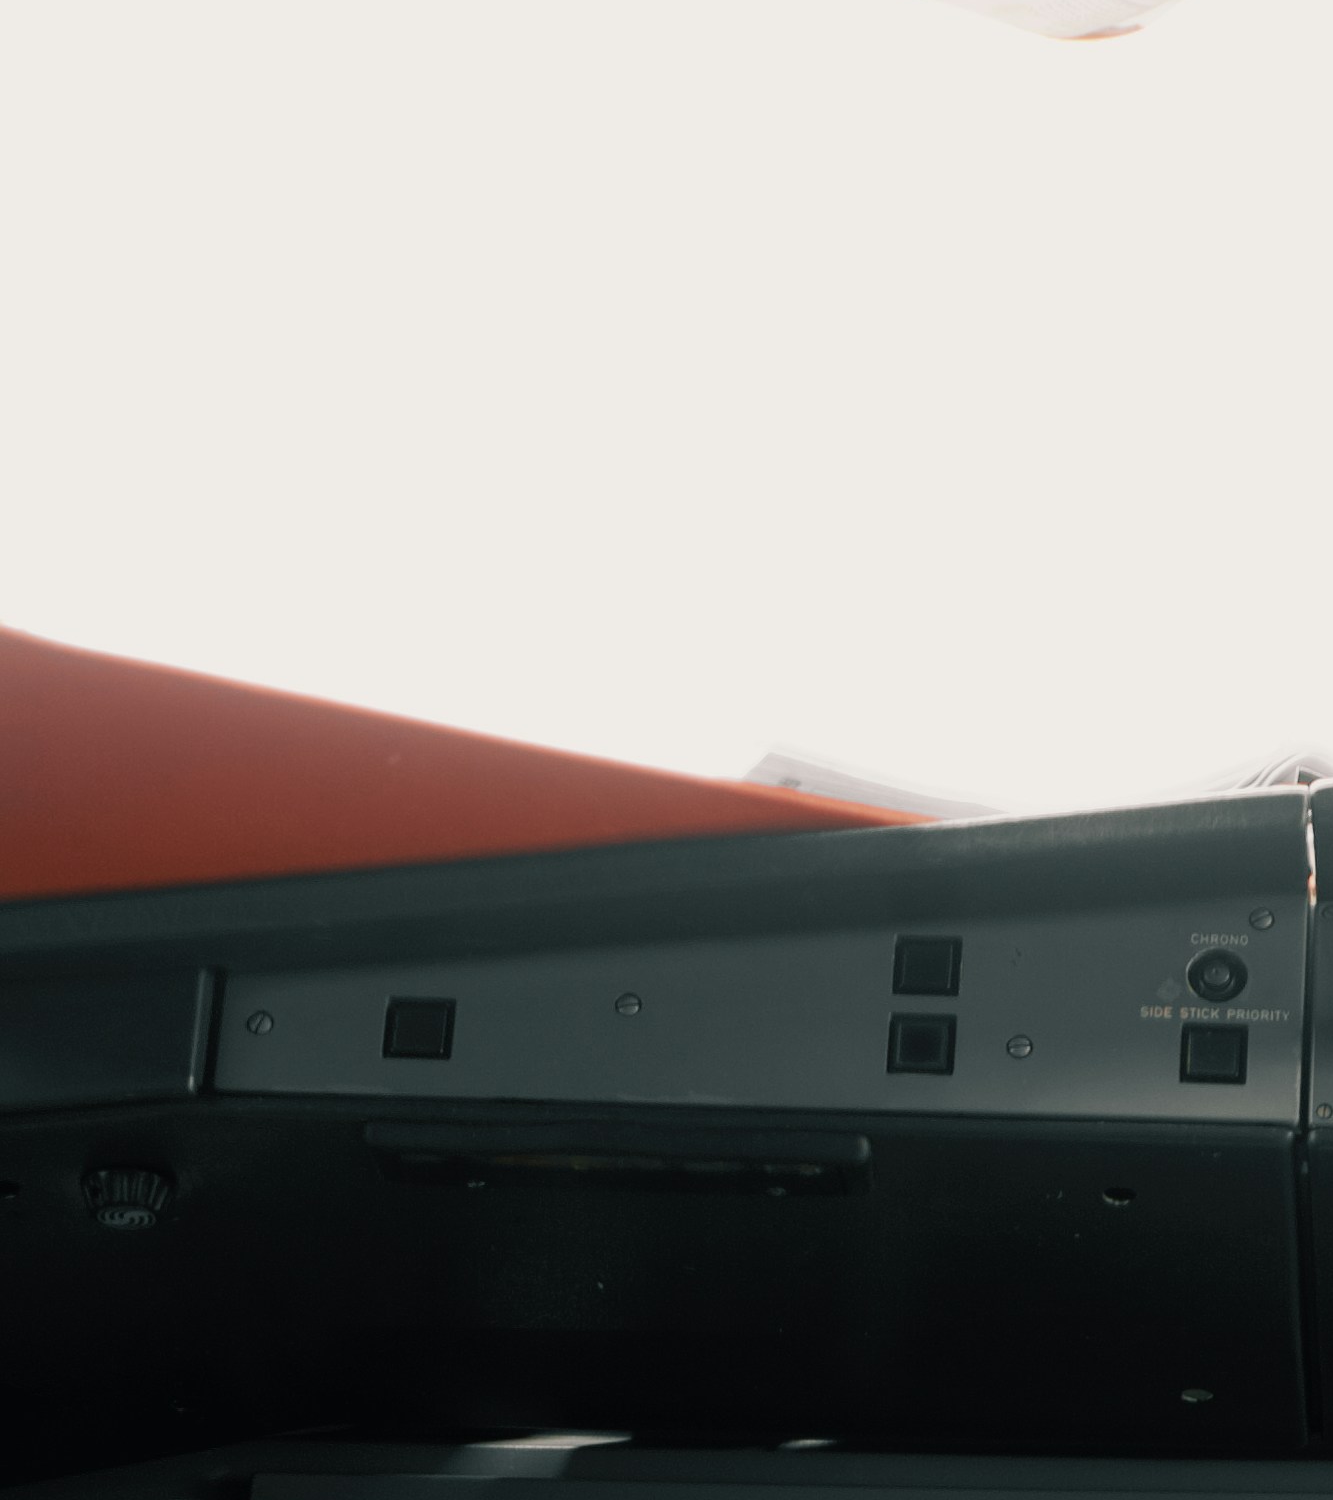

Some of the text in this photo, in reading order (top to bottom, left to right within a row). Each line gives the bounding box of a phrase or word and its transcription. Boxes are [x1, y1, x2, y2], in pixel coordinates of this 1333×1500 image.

[1189, 932, 1250, 946] CHRONO
[1139, 1005, 1291, 1023] SIDE STICK PRIORITY
